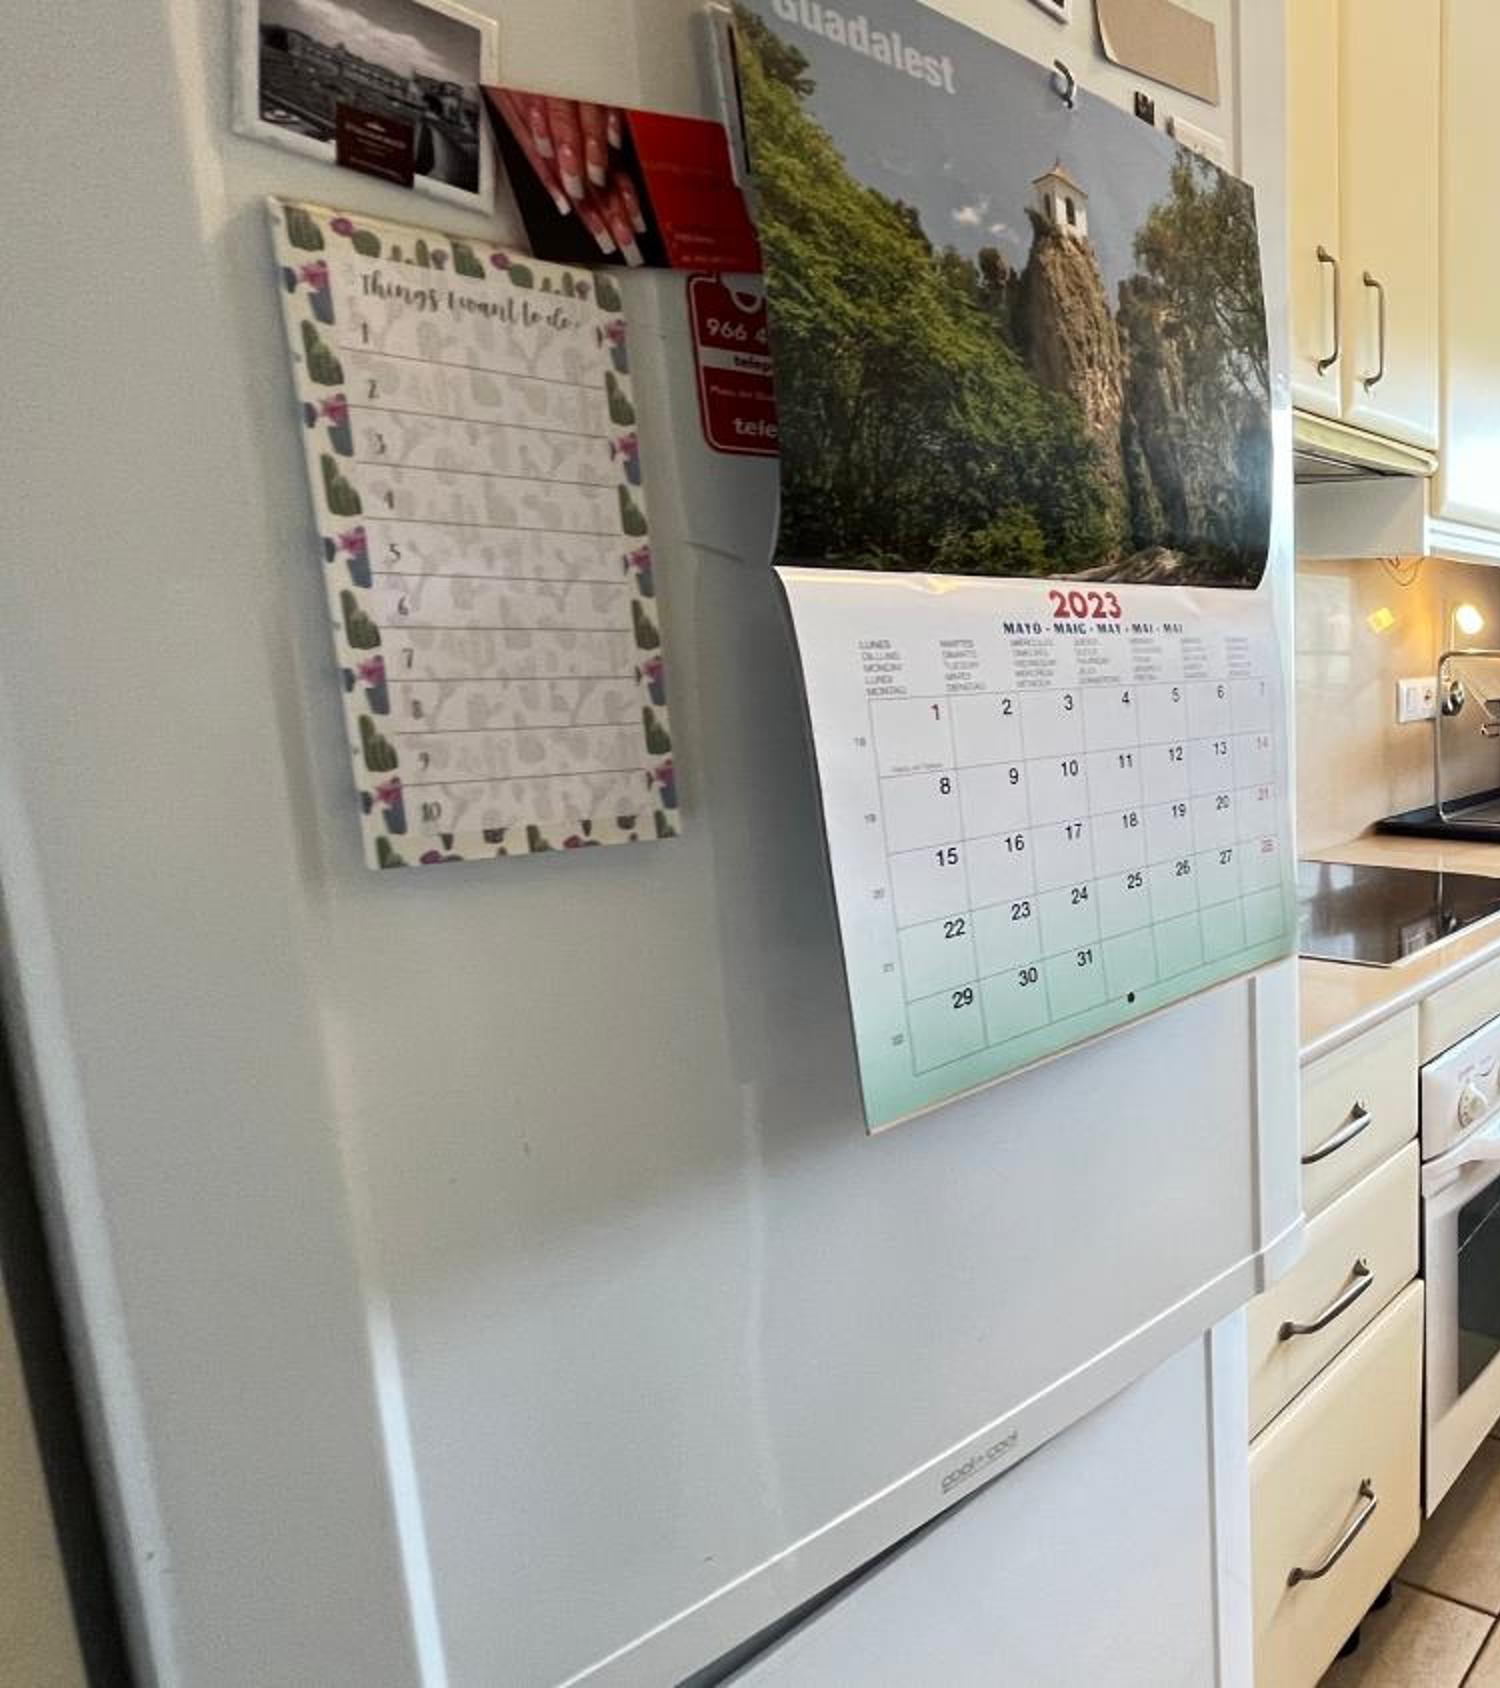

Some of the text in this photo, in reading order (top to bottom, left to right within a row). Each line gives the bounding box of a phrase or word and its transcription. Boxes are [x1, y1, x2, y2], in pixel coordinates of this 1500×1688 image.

[772, 0, 956, 95] Guadalest
[361, 269, 438, 312] Things
[459, 296, 515, 323] want
[521, 300, 541, 327] to
[706, 317, 748, 341] 966
[367, 379, 380, 399] 2
[389, 542, 401, 563] 5
[1050, 590, 1122, 619] 2023
[1003, 622, 1042, 635] MAYO
[402, 648, 414, 669] 7
[931, 704, 940, 720] 1
[1001, 699, 1013, 715] 2
[1064, 695, 1074, 711] 3
[1121, 691, 1130, 706] 4
[1171, 687, 1181, 702] 5
[1217, 685, 1225, 699] 6
[939, 777, 952, 794] 8
[1009, 767, 1020, 785] 9
[1061, 760, 1080, 776] 10
[1118, 753, 1133, 768] 11
[1168, 746, 1184, 761] 12
[1213, 741, 1228, 755] 13
[935, 848, 958, 866] 15
[1004, 835, 1025, 852] 16
[1065, 823, 1083, 840] 17
[1122, 812, 1139, 828] 18
[1171, 803, 1187, 817] 19
[1216, 795, 1231, 810] 20
[943, 918, 966, 939] 22
[1011, 901, 1032, 921] 23
[1071, 886, 1090, 905] 24
[1126, 872, 1144, 889] 25
[1175, 860, 1192, 876] 26
[1218, 850, 1234, 865] 27
[951, 949, 1094, 1009] 29 30 31
